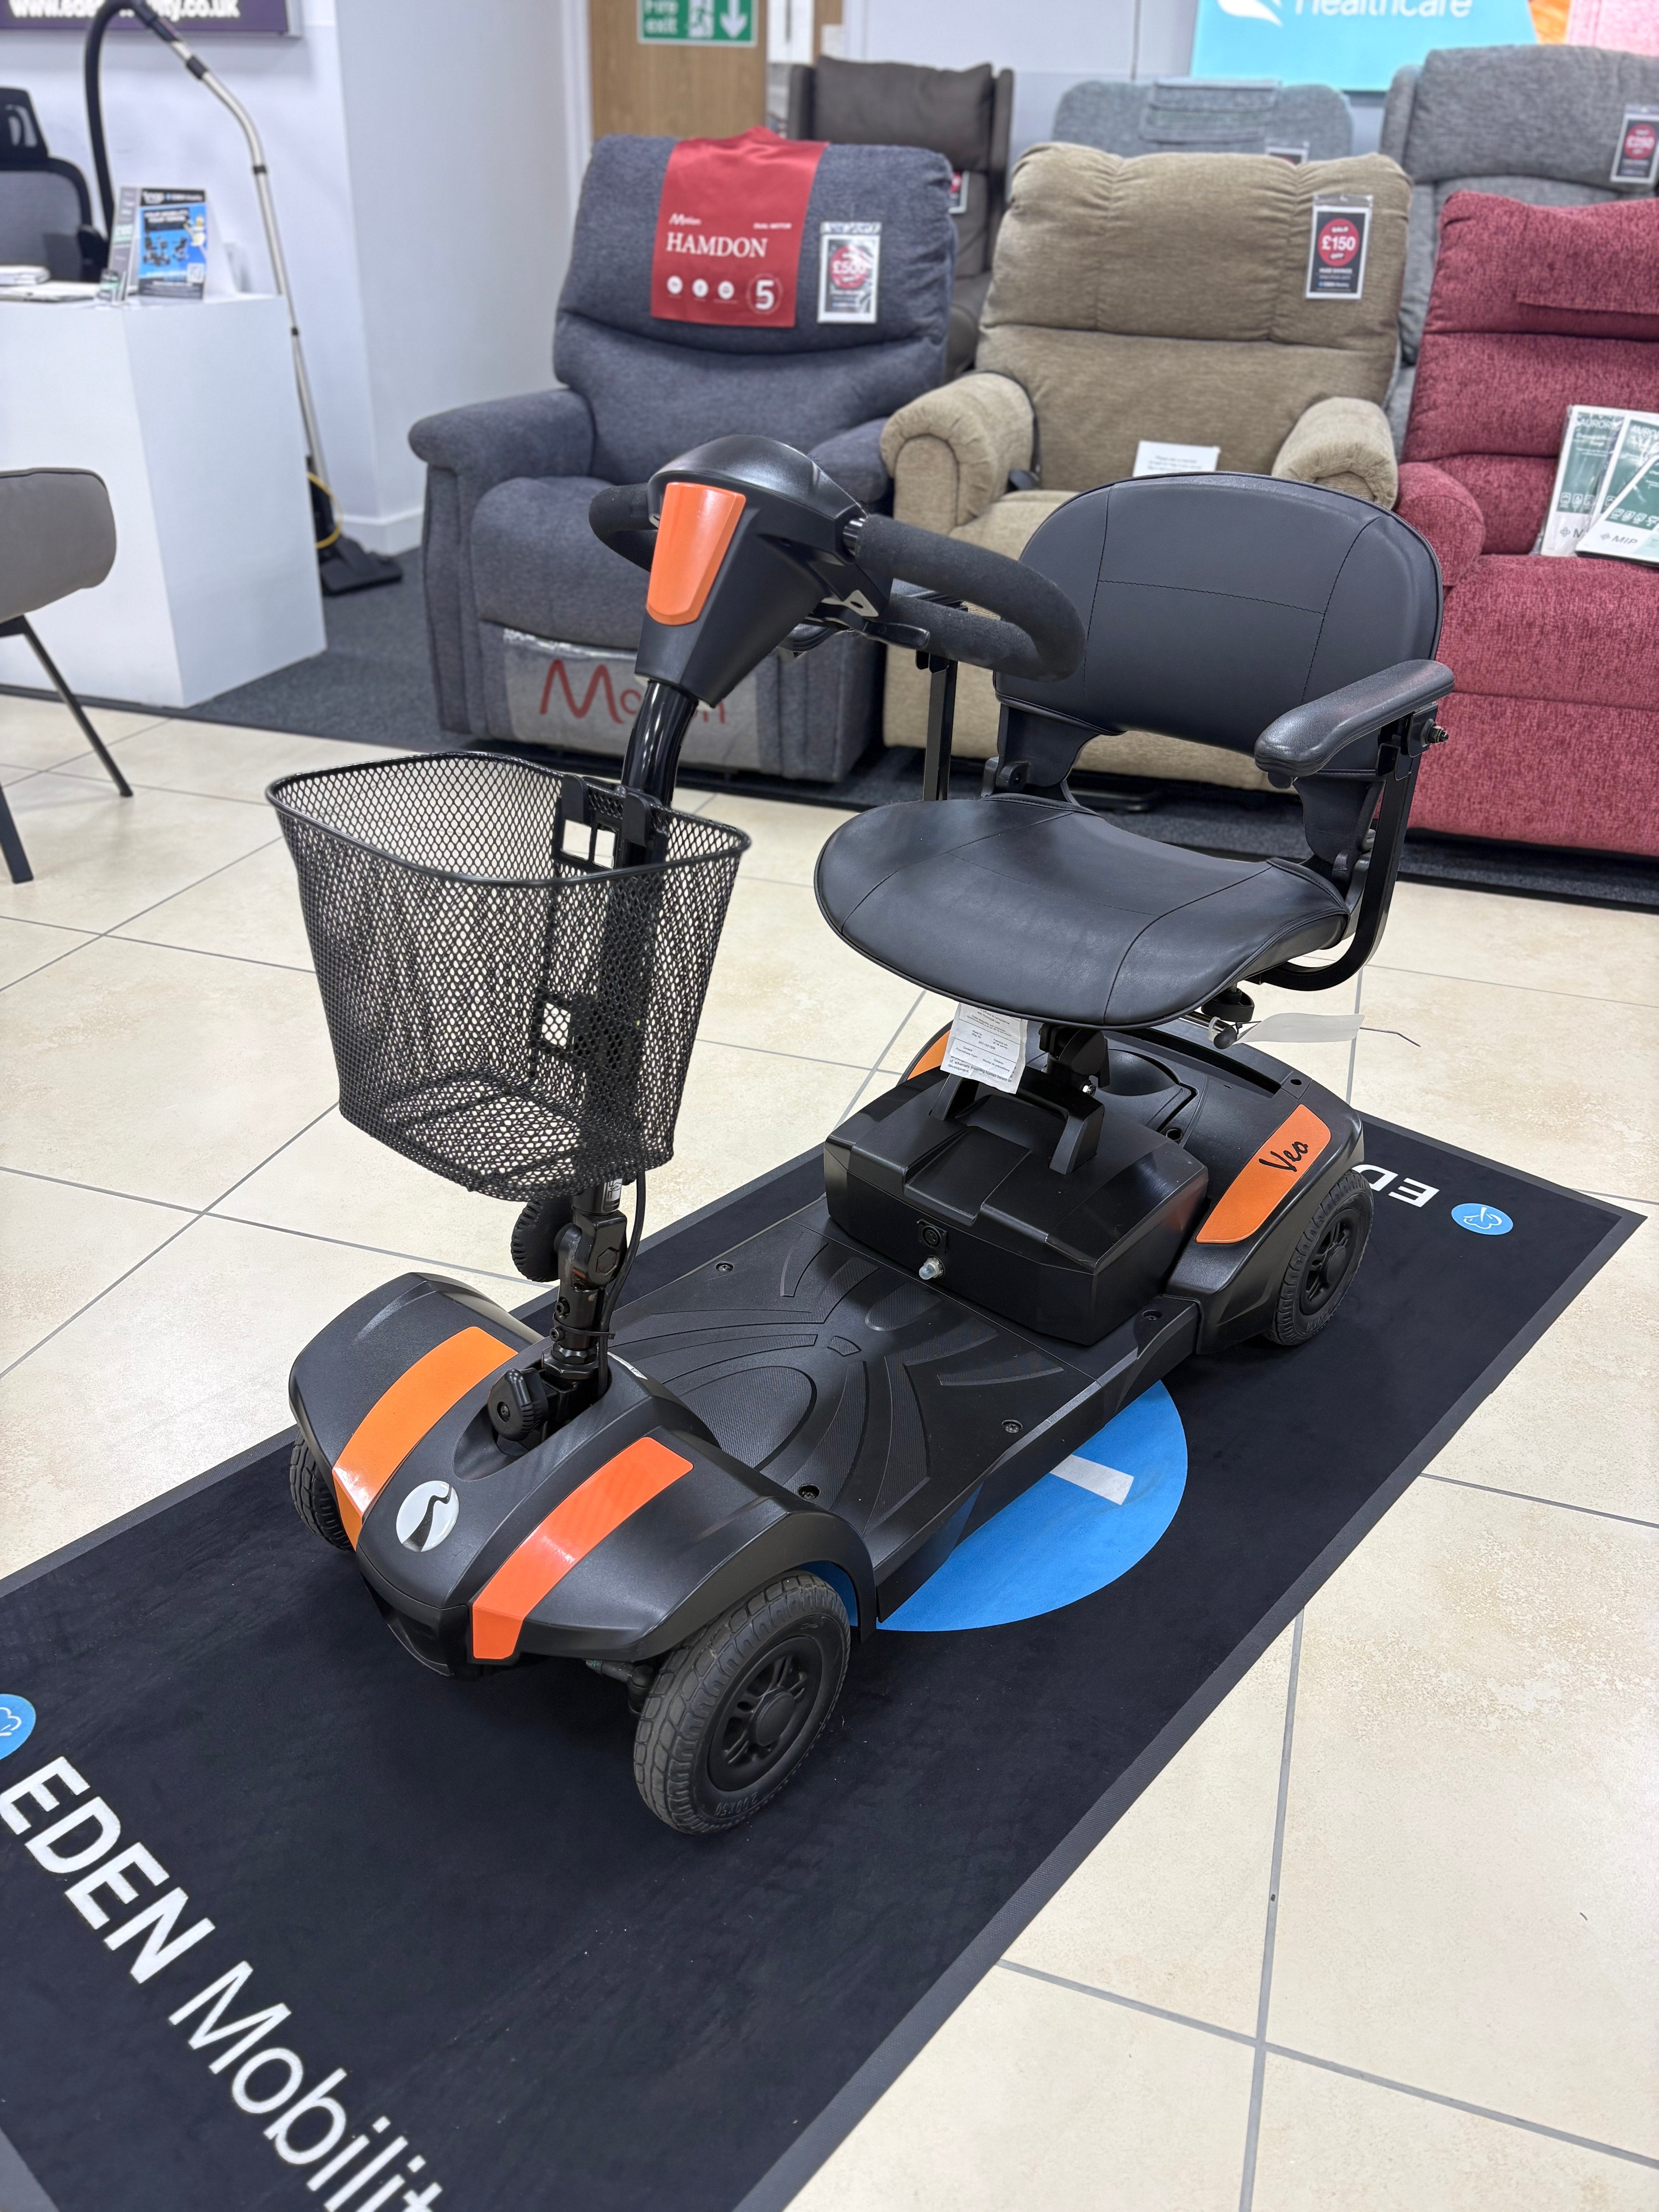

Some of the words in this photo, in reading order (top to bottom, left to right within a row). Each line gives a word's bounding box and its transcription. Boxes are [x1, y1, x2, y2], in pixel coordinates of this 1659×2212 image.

[666, 232, 768, 258] HAMDON
[1321, 235, 1356, 252] £150
[755, 280, 775, 310] 5
[1611, 535, 1638, 544] MIP
[1259, 1141, 1308, 1172] Veo
[0, 1756, 215, 1984] EDEN
